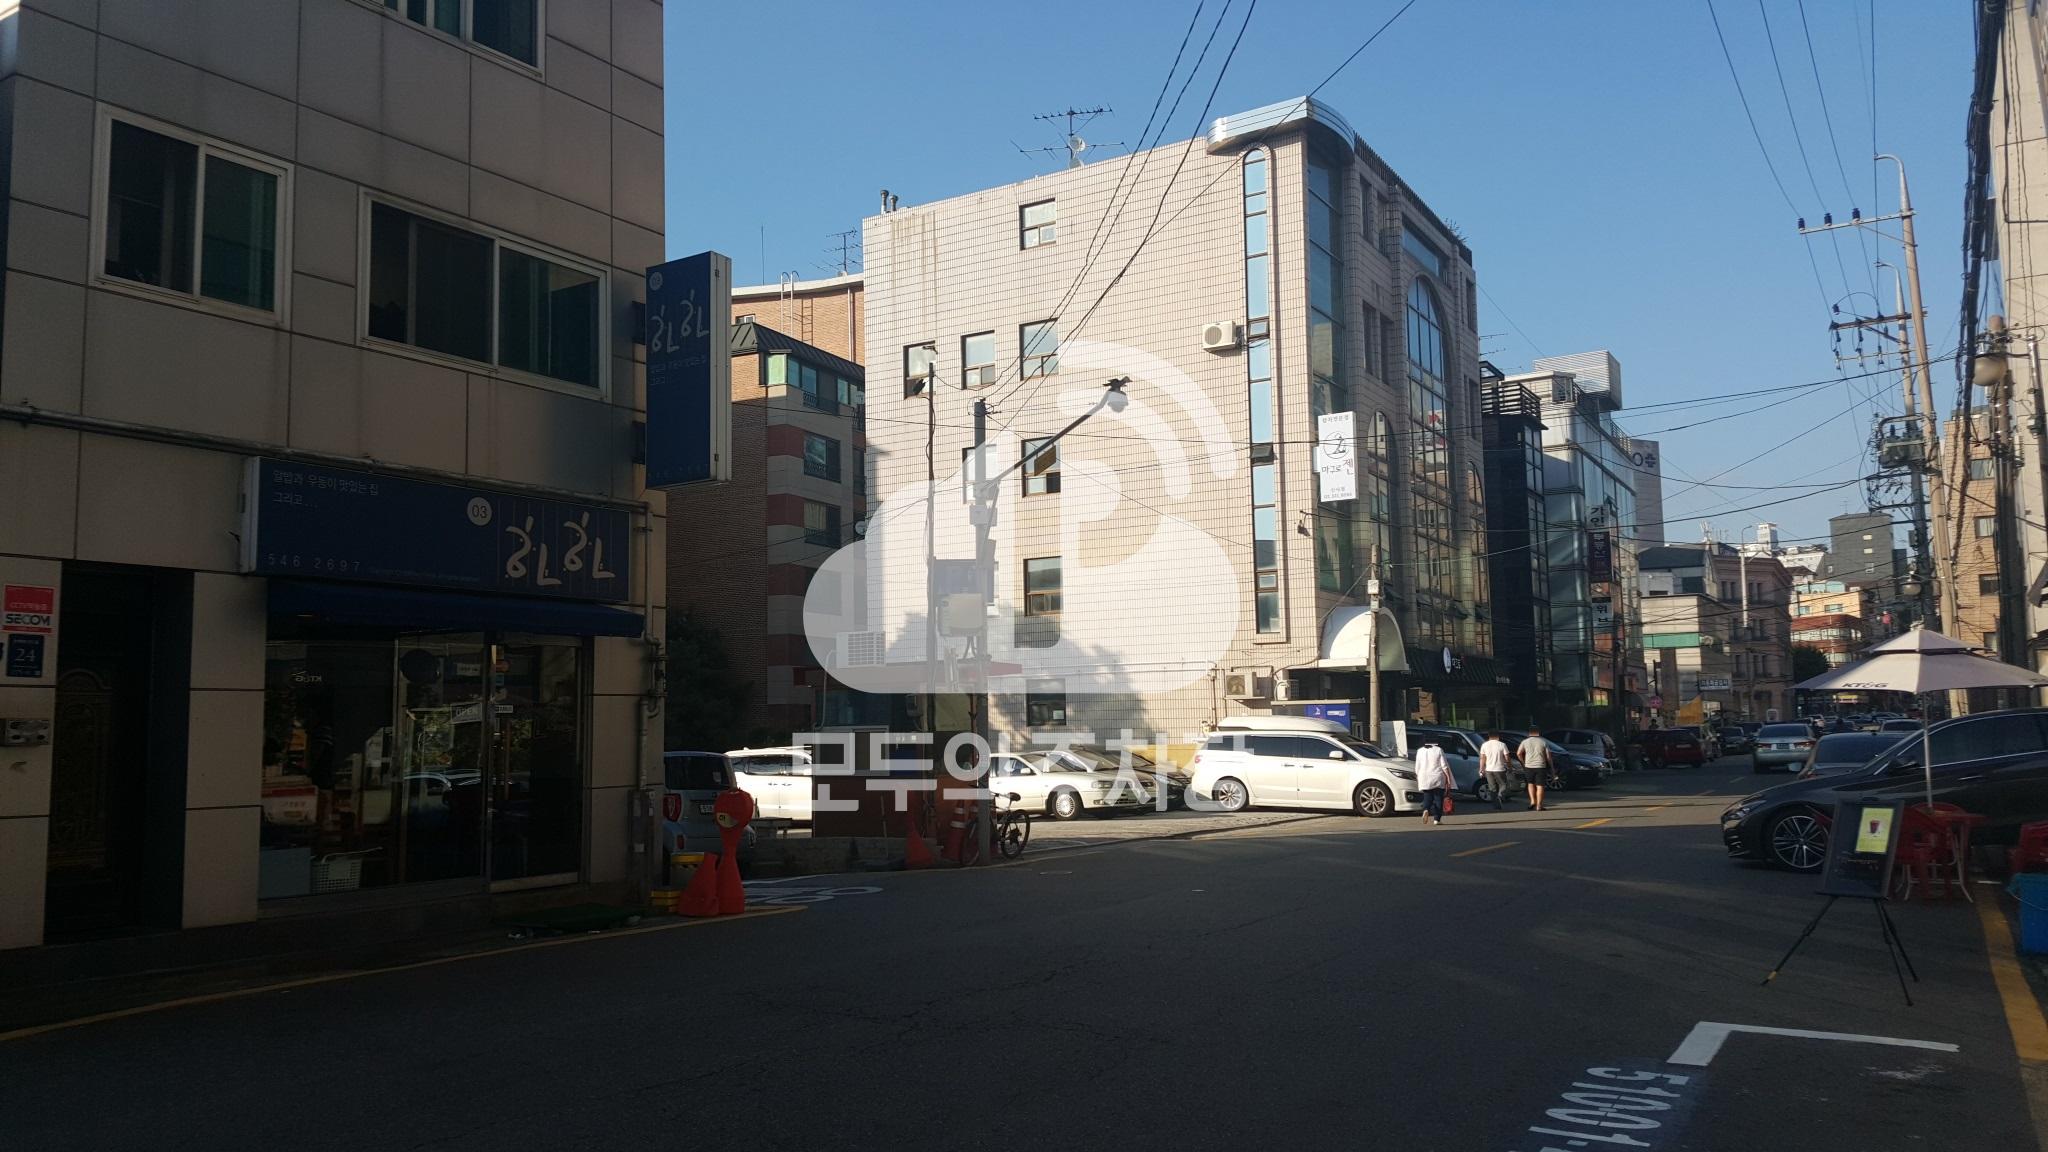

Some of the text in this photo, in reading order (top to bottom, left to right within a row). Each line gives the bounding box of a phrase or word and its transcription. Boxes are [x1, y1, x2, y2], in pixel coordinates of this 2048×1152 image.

[472, 505, 488, 519] 03
[268, 553, 361, 572] 546 2697
[5, 614, 50, 625] SECOM
[15, 648, 36, 662] 24
[455, 707, 479, 717] OPEN
